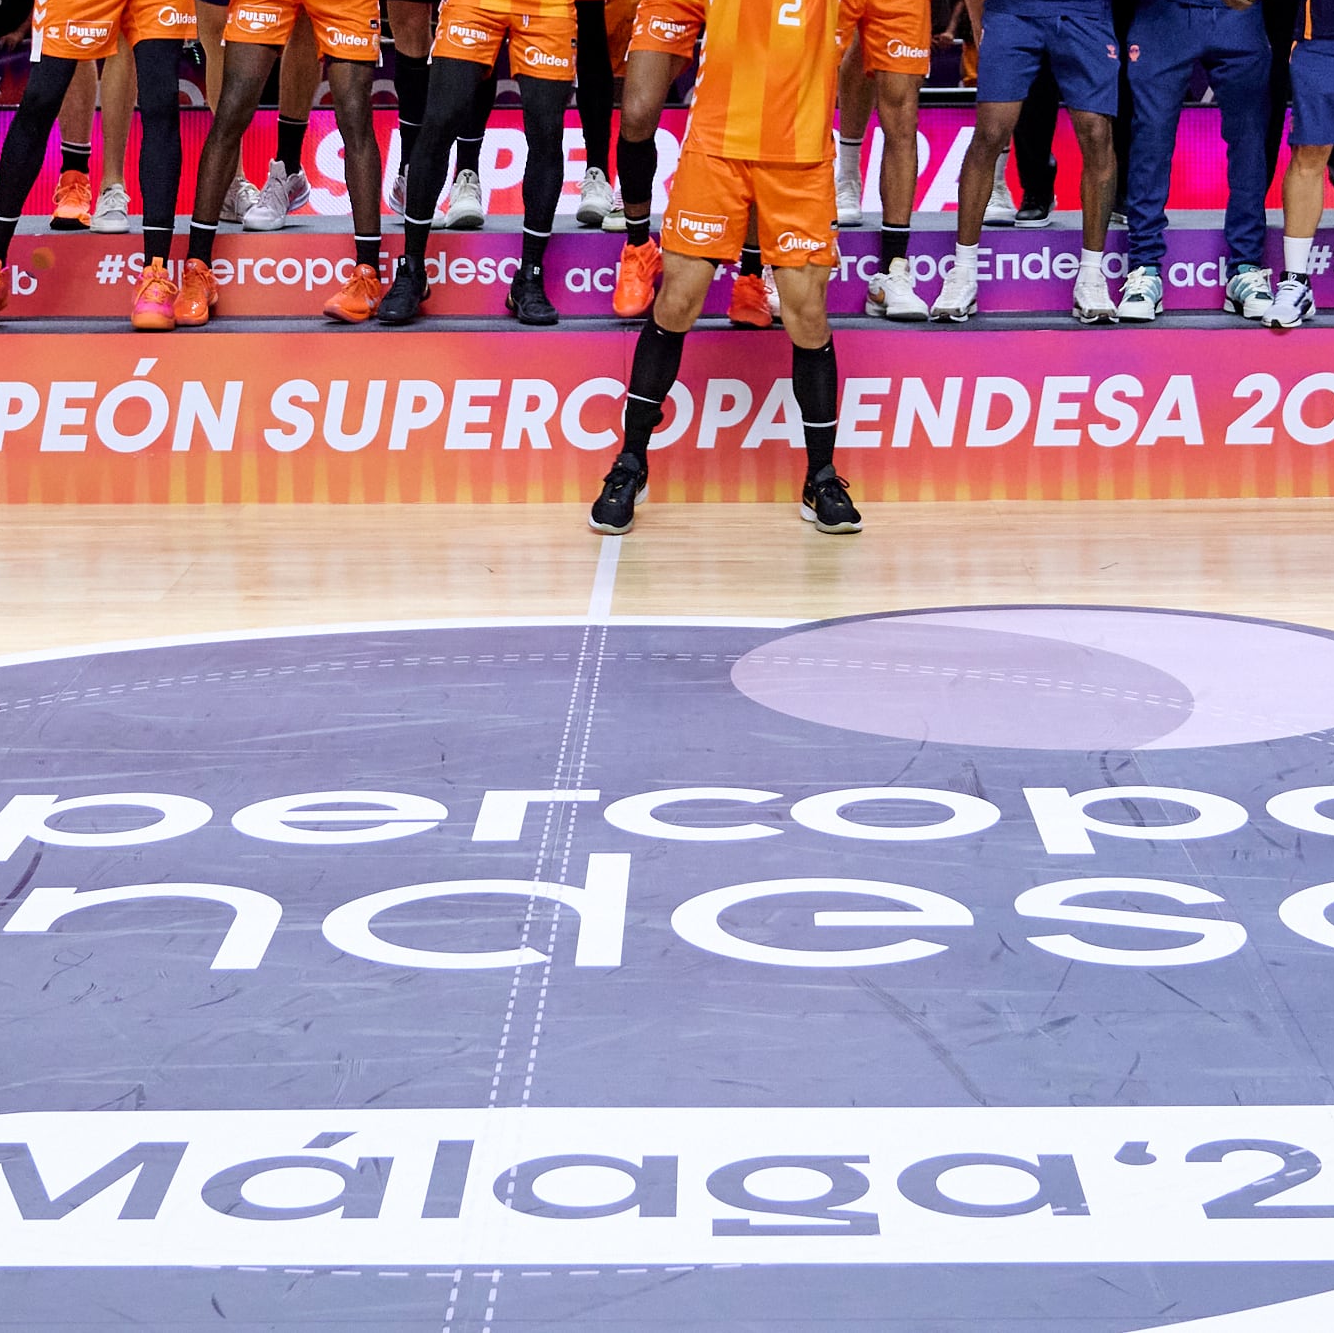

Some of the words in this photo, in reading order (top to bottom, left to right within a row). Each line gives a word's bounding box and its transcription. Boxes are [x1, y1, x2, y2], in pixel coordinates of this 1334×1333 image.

[238, 10, 276, 24] PULEVA
[69, 26, 107, 36] PULEVA
[450, 26, 486, 41] PULEVA
[681, 218, 724, 233] PULEVA
[264, 377, 808, 452] SUPERCOPA
[833, 374, 1204, 448] ENDESA
